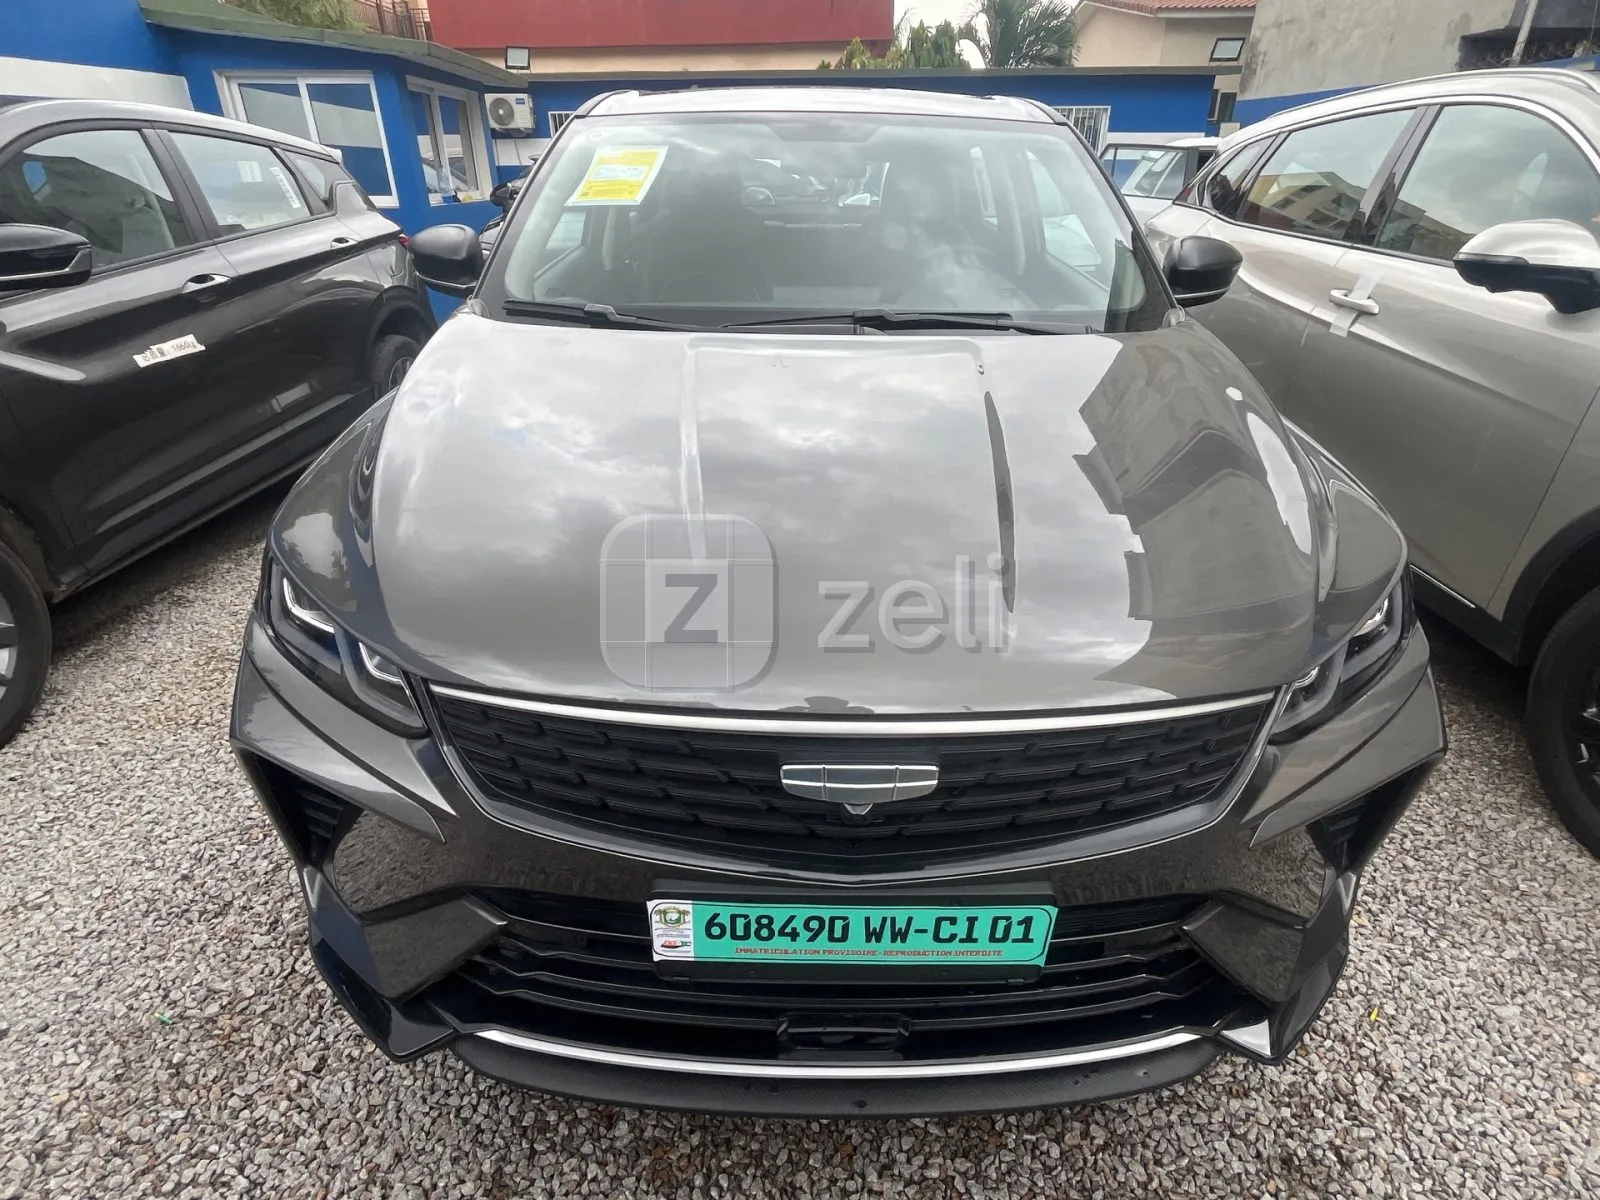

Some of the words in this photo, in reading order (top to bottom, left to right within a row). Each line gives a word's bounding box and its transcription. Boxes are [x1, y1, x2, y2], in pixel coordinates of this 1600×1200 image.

[704, 912, 850, 943] 608490
[988, 915, 1034, 944] 01
[735, 947, 820, 955] IMMATRICULATION
[953, 949, 1003, 957] INTERDITE
